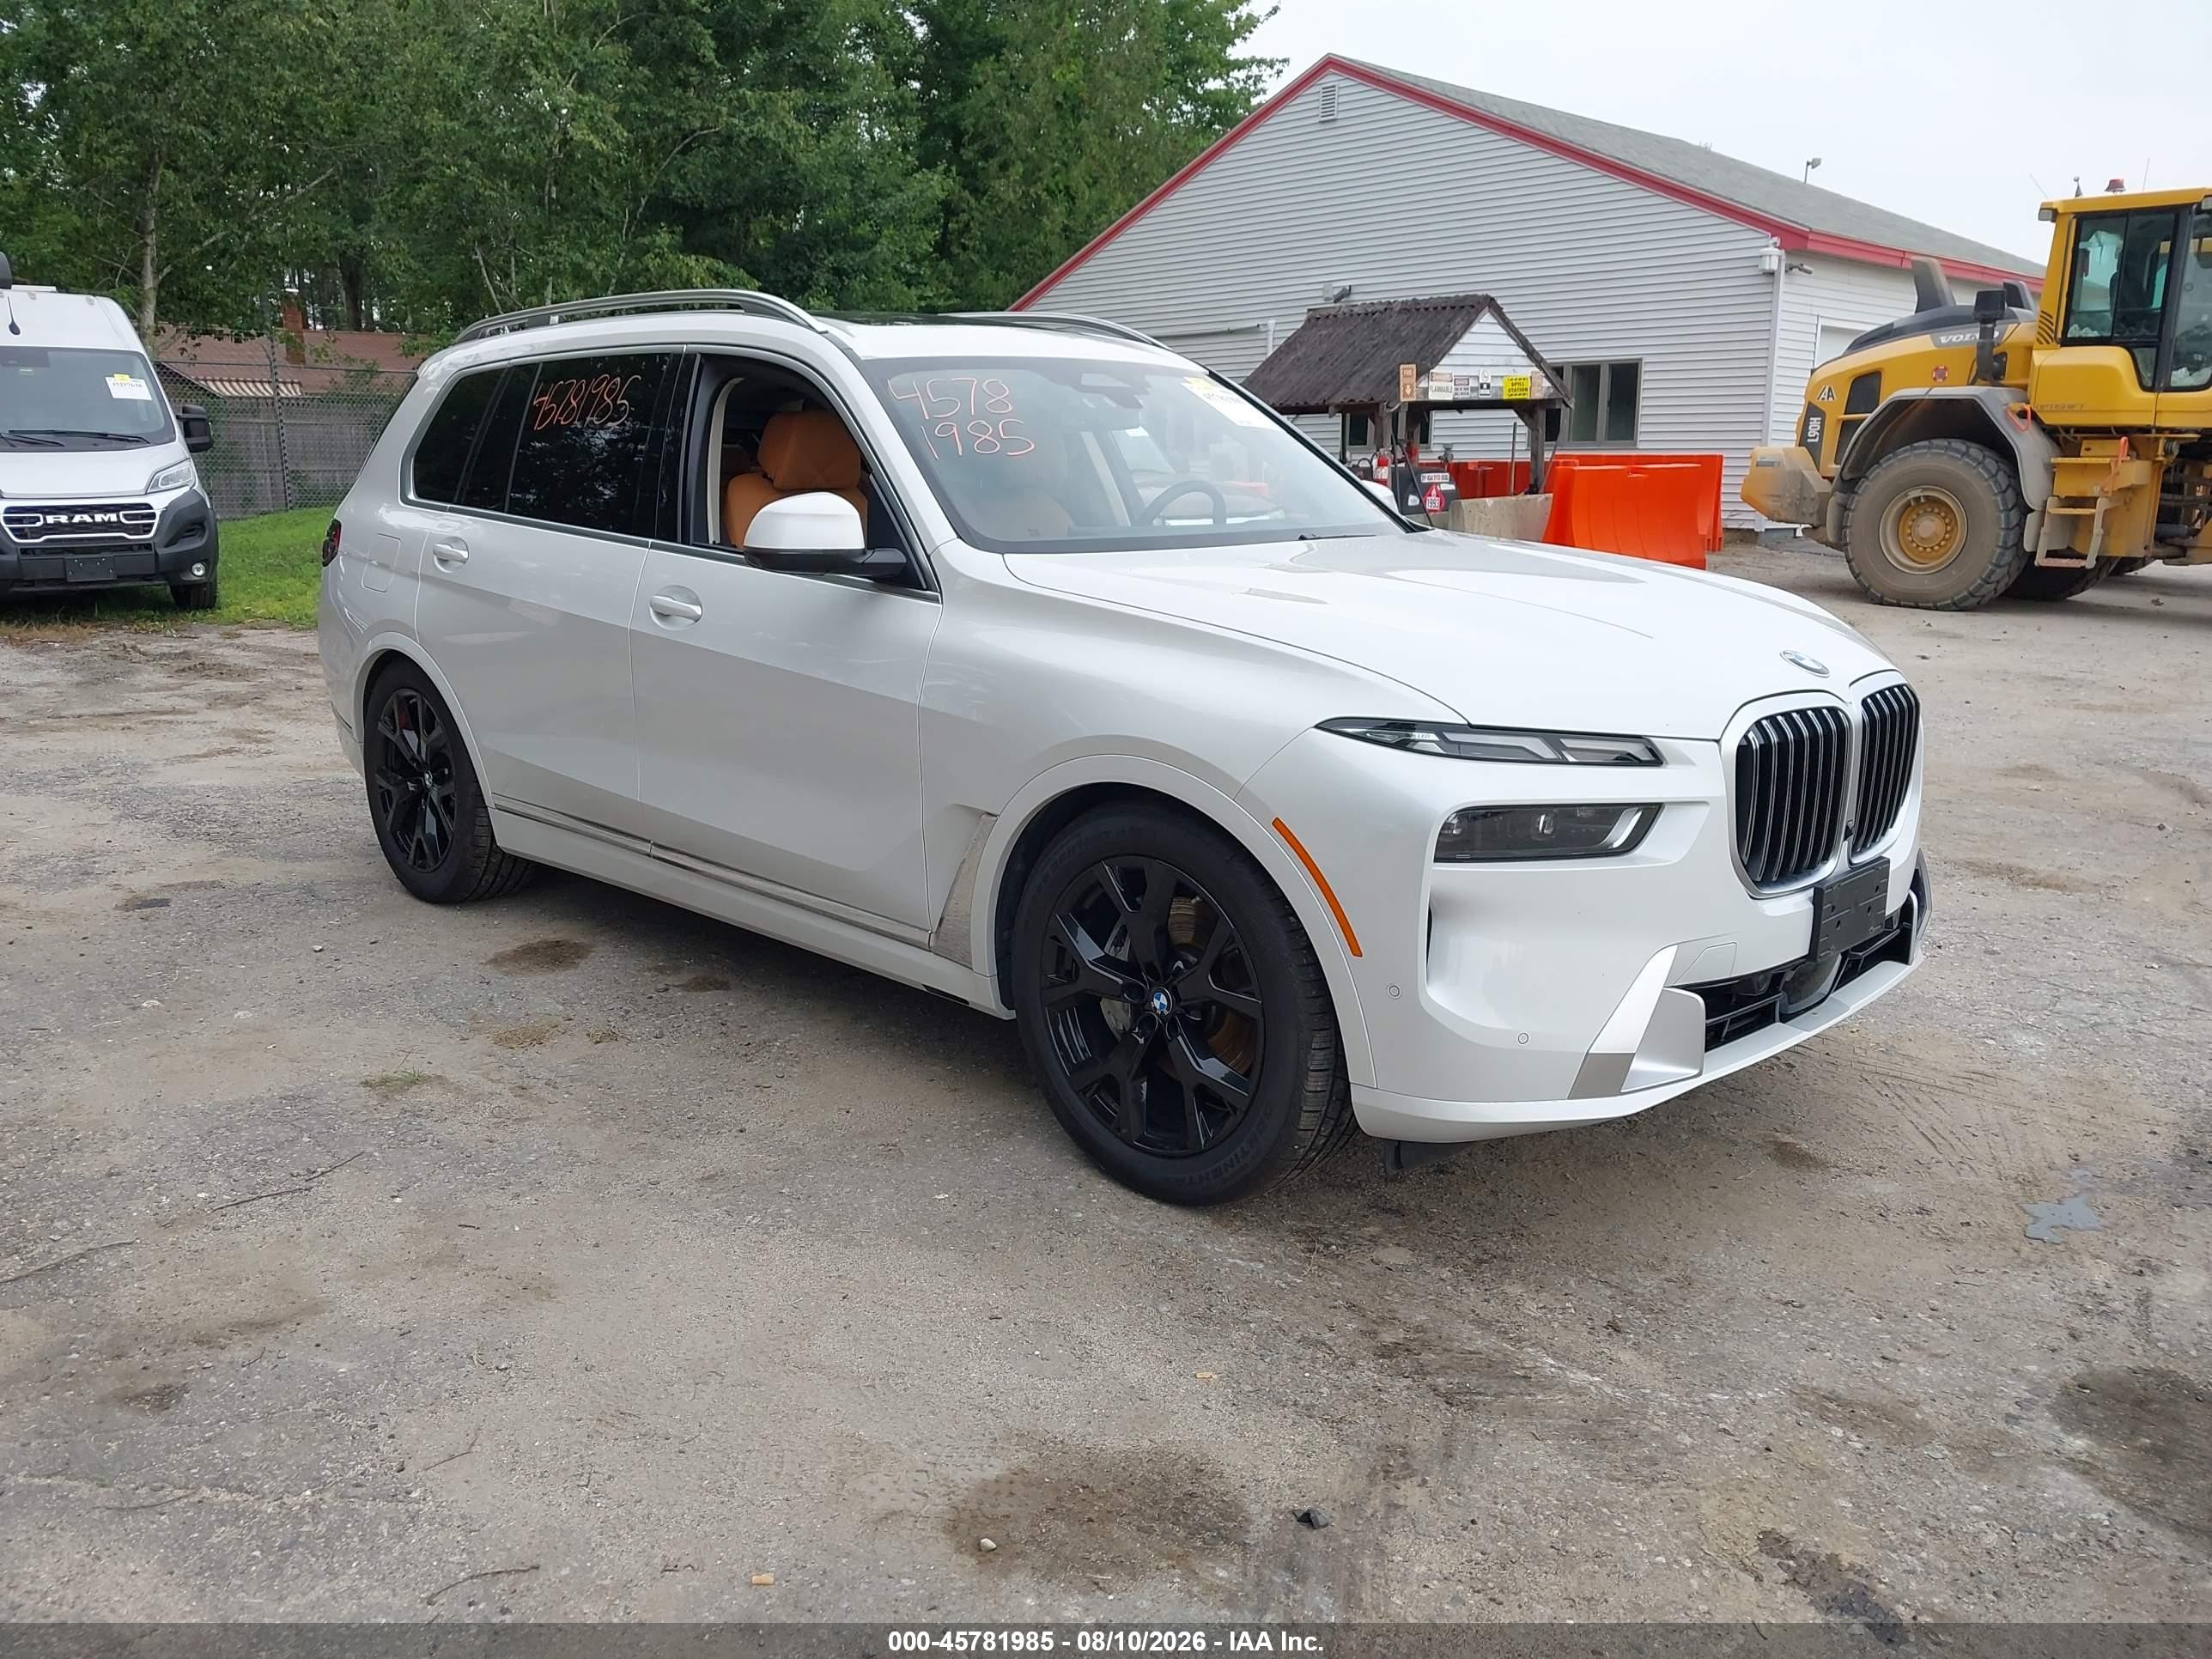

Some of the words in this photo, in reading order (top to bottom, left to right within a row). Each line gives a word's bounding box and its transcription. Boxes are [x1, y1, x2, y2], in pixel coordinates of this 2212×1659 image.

[887, 377, 1013, 420] 4578
[921, 418, 1036, 461] 1985
[1807, 416, 1822, 444] L90H
[1427, 497, 1439, 509] 1993
[46, 513, 118, 524] RAM
